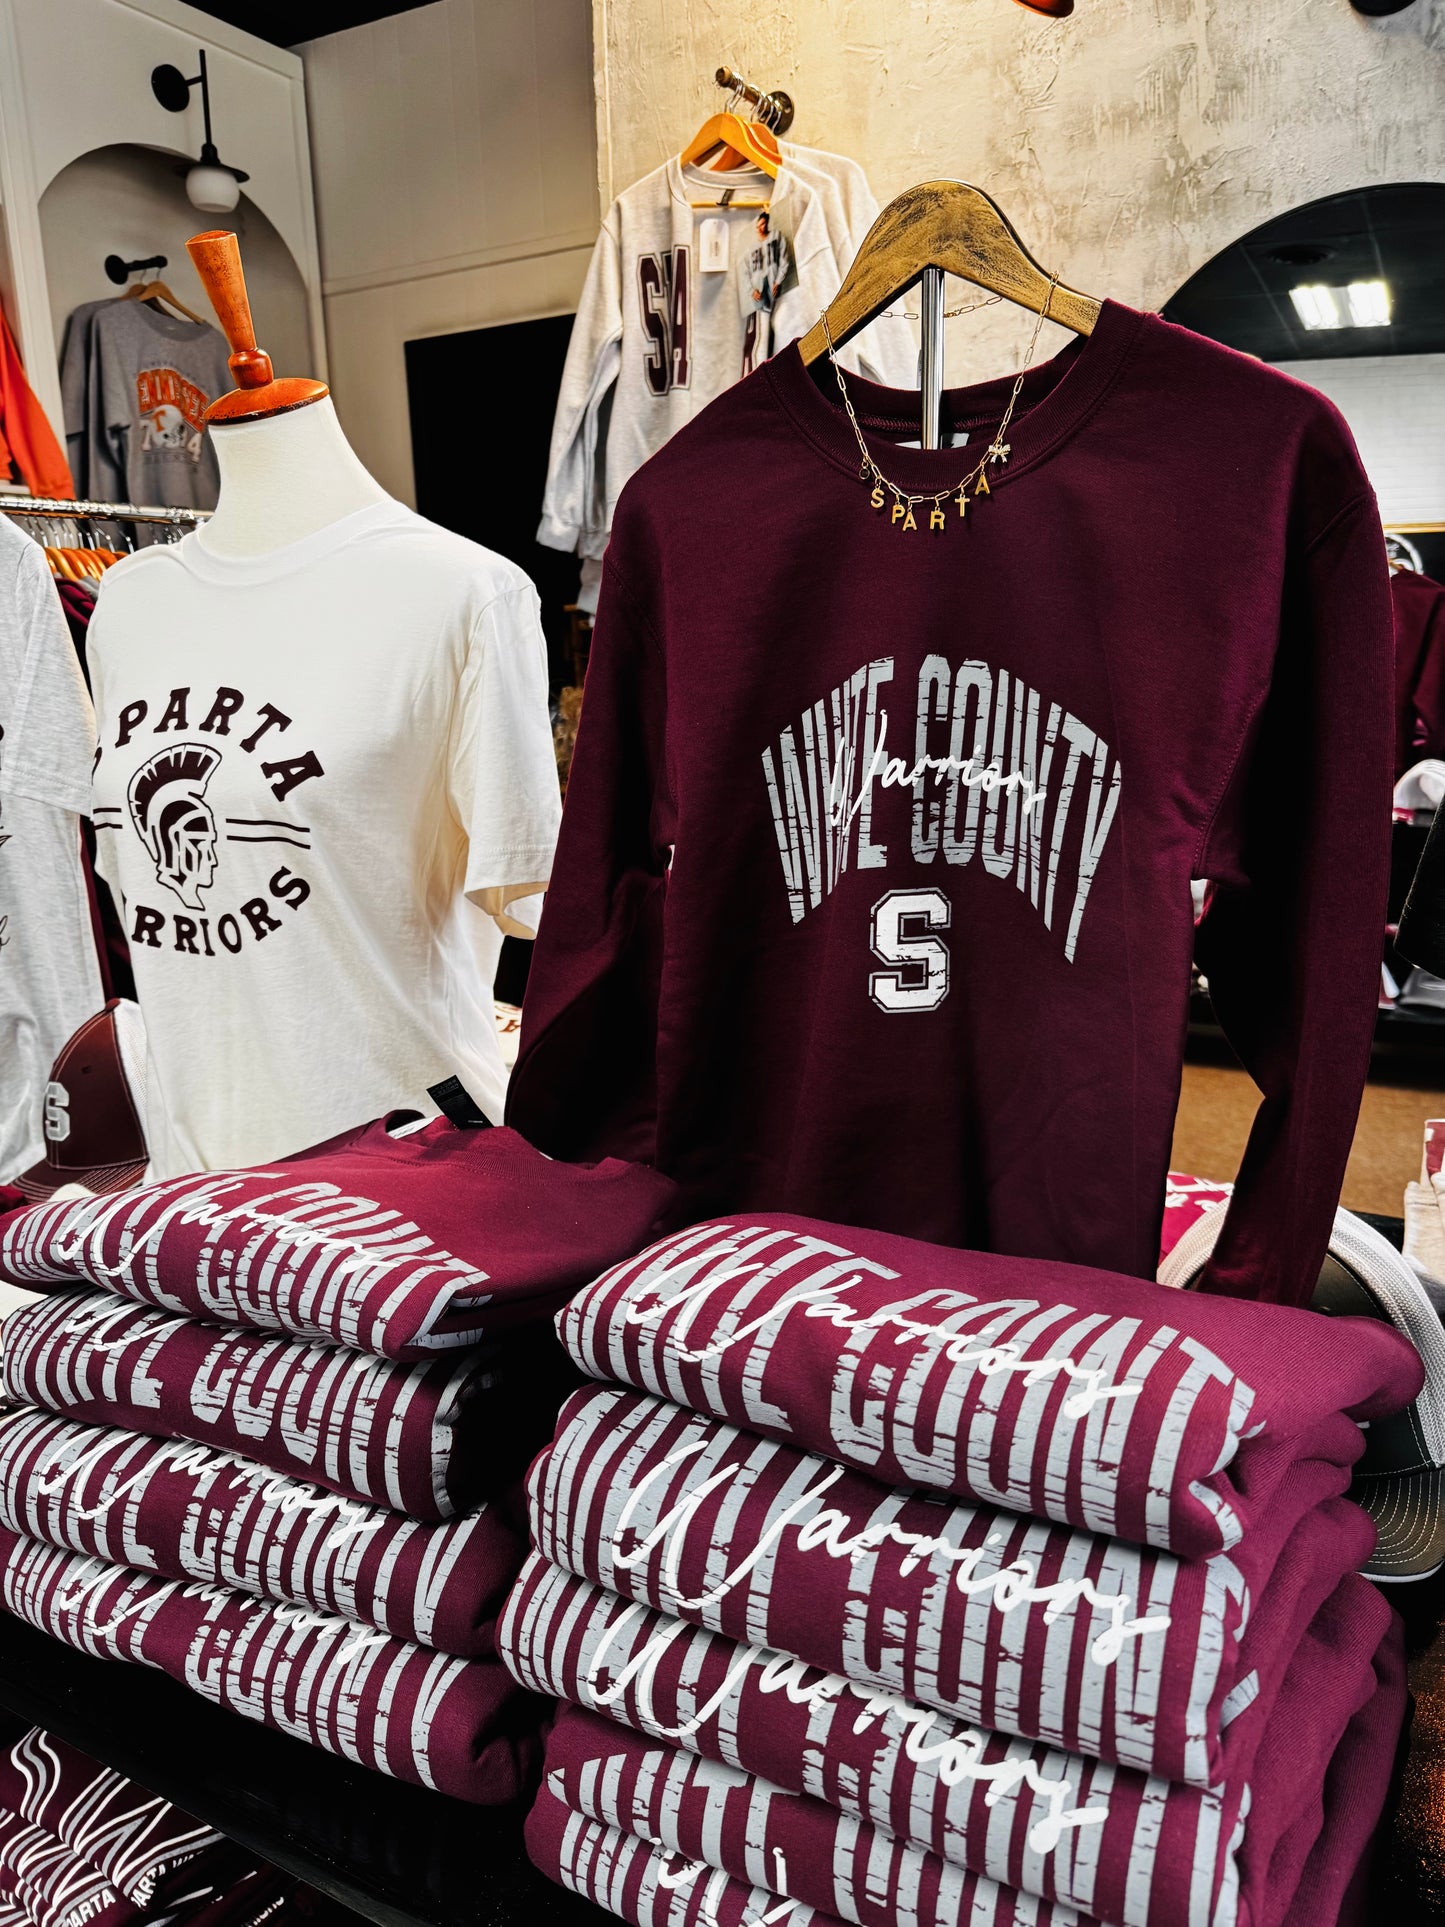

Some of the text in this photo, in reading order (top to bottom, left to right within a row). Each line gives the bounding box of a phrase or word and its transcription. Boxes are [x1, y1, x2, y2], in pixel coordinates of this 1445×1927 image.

[870, 473, 991, 532] SPARTA
[92, 687, 325, 802] PARTA
[761, 653, 1122, 965] WHITE COUNTY
[121, 865, 311, 956] RRIORS
[868, 886, 952, 1014] S
[44, 1081, 71, 1142] S
